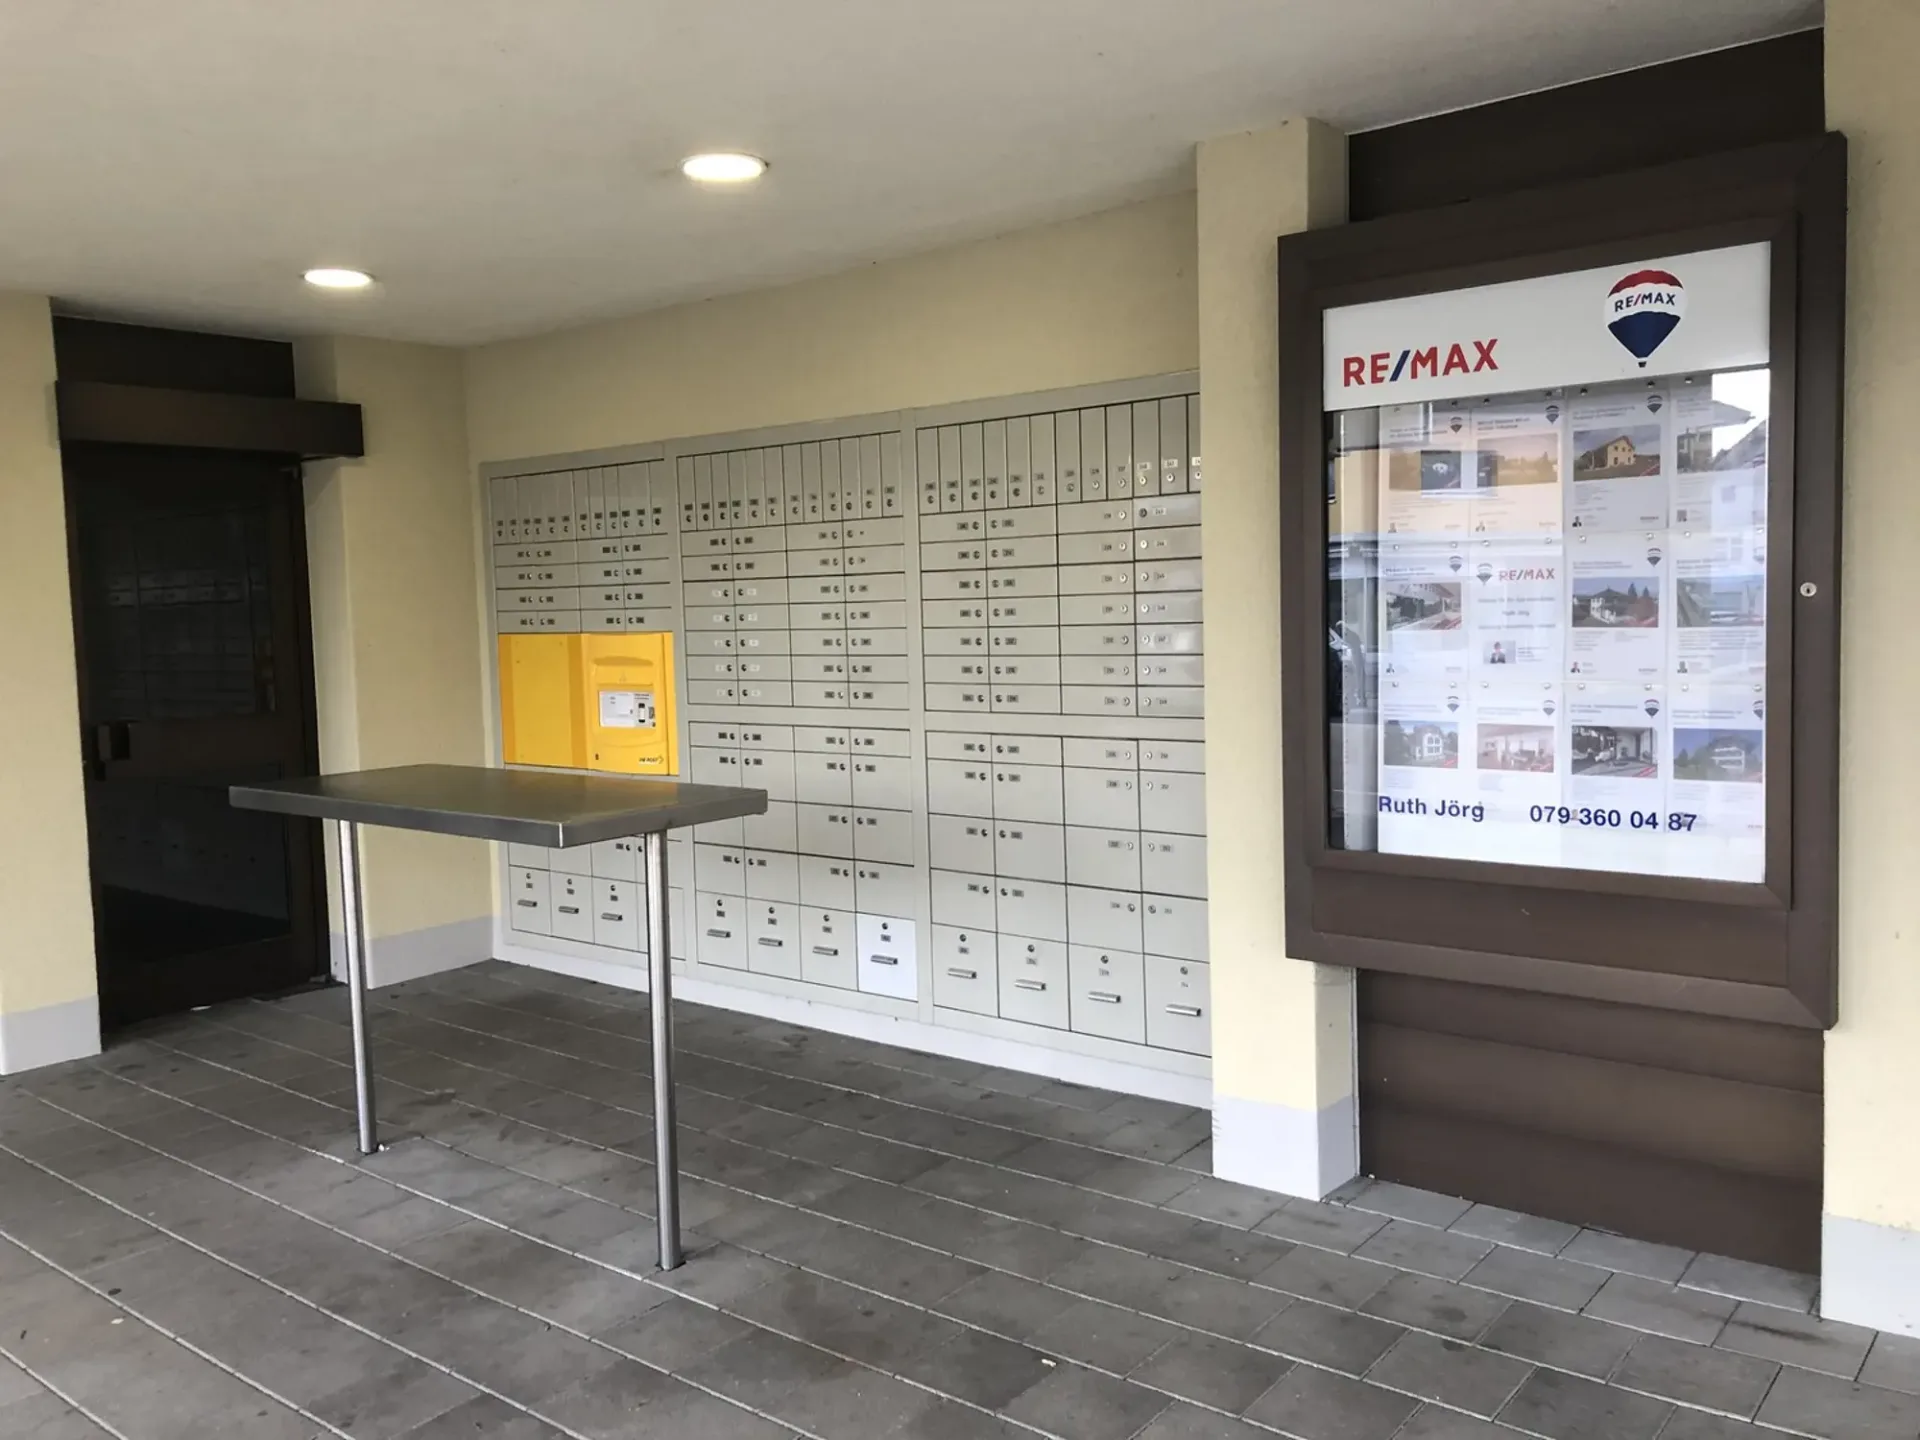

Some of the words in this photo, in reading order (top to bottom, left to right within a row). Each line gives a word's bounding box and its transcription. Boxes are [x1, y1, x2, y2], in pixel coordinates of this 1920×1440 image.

[1613, 291, 1676, 313] RE/MAX
[1343, 338, 1499, 388] RE/MAX
[1499, 567, 1556, 581] RE/MAX
[1378, 795, 1427, 815] Ruth
[1435, 799, 1484, 822] Jörg
[1530, 805, 1570, 824] 079
[1578, 807, 1621, 828] 360
[1629, 810, 1659, 830] 04
[1668, 812, 1697, 832] 87
